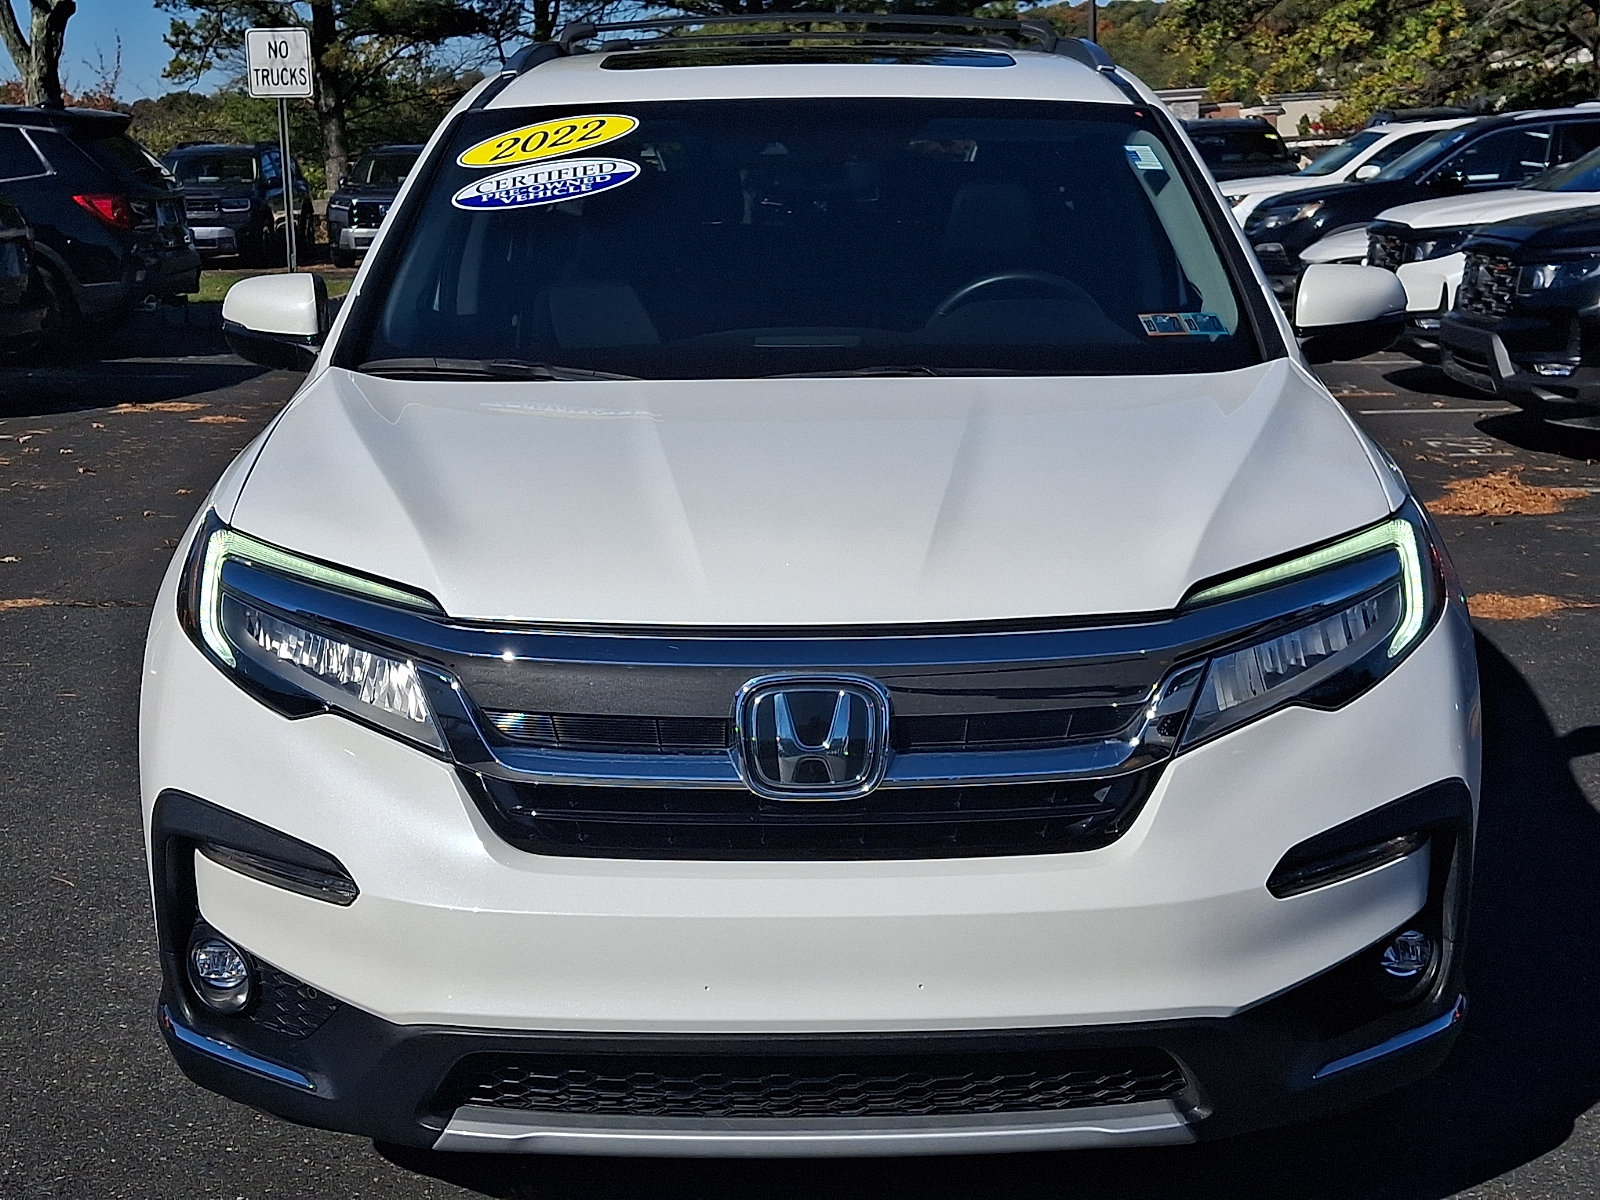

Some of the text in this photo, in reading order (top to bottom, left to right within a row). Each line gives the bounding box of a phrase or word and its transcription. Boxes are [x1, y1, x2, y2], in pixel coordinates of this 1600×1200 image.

[267, 40, 289, 59] NO
[253, 67, 307, 87] TRUCKS
[490, 119, 607, 162] 2022
[475, 162, 618, 194] CERTIFIED
[481, 174, 612, 202] PRE-OWNED
[500, 181, 593, 204] VEHICLE
